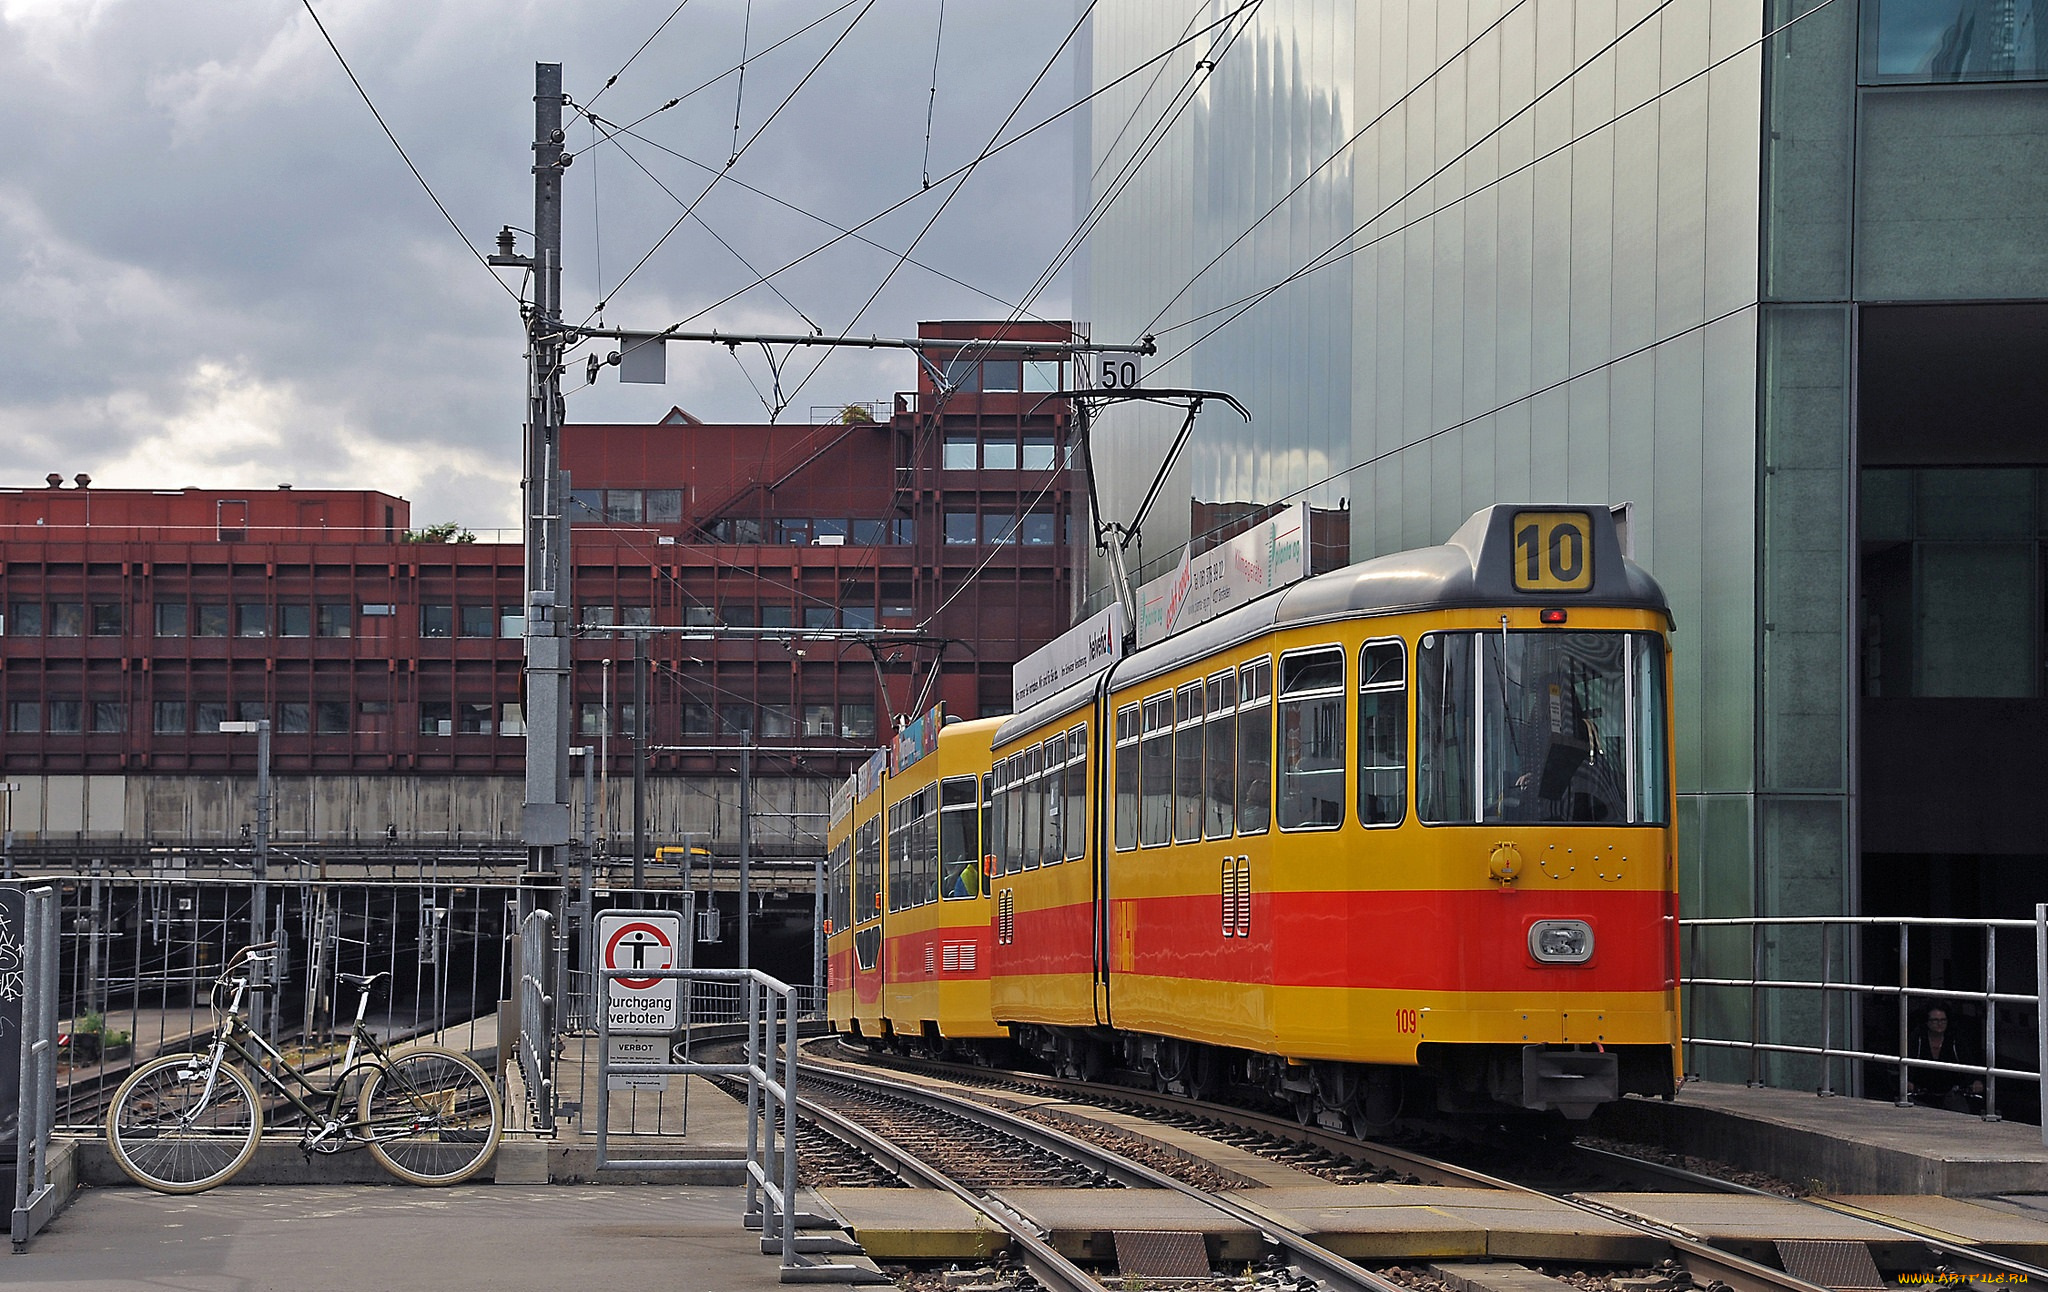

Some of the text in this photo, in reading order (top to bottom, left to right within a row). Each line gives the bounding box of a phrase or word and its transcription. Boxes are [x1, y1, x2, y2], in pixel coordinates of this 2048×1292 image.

[1101, 361, 1136, 389] 50
[1518, 523, 1582, 582] 10
[1089, 626, 1106, 662] helvetia
[609, 1011, 665, 1024] verboten
[1396, 1008, 1417, 1034] 109
